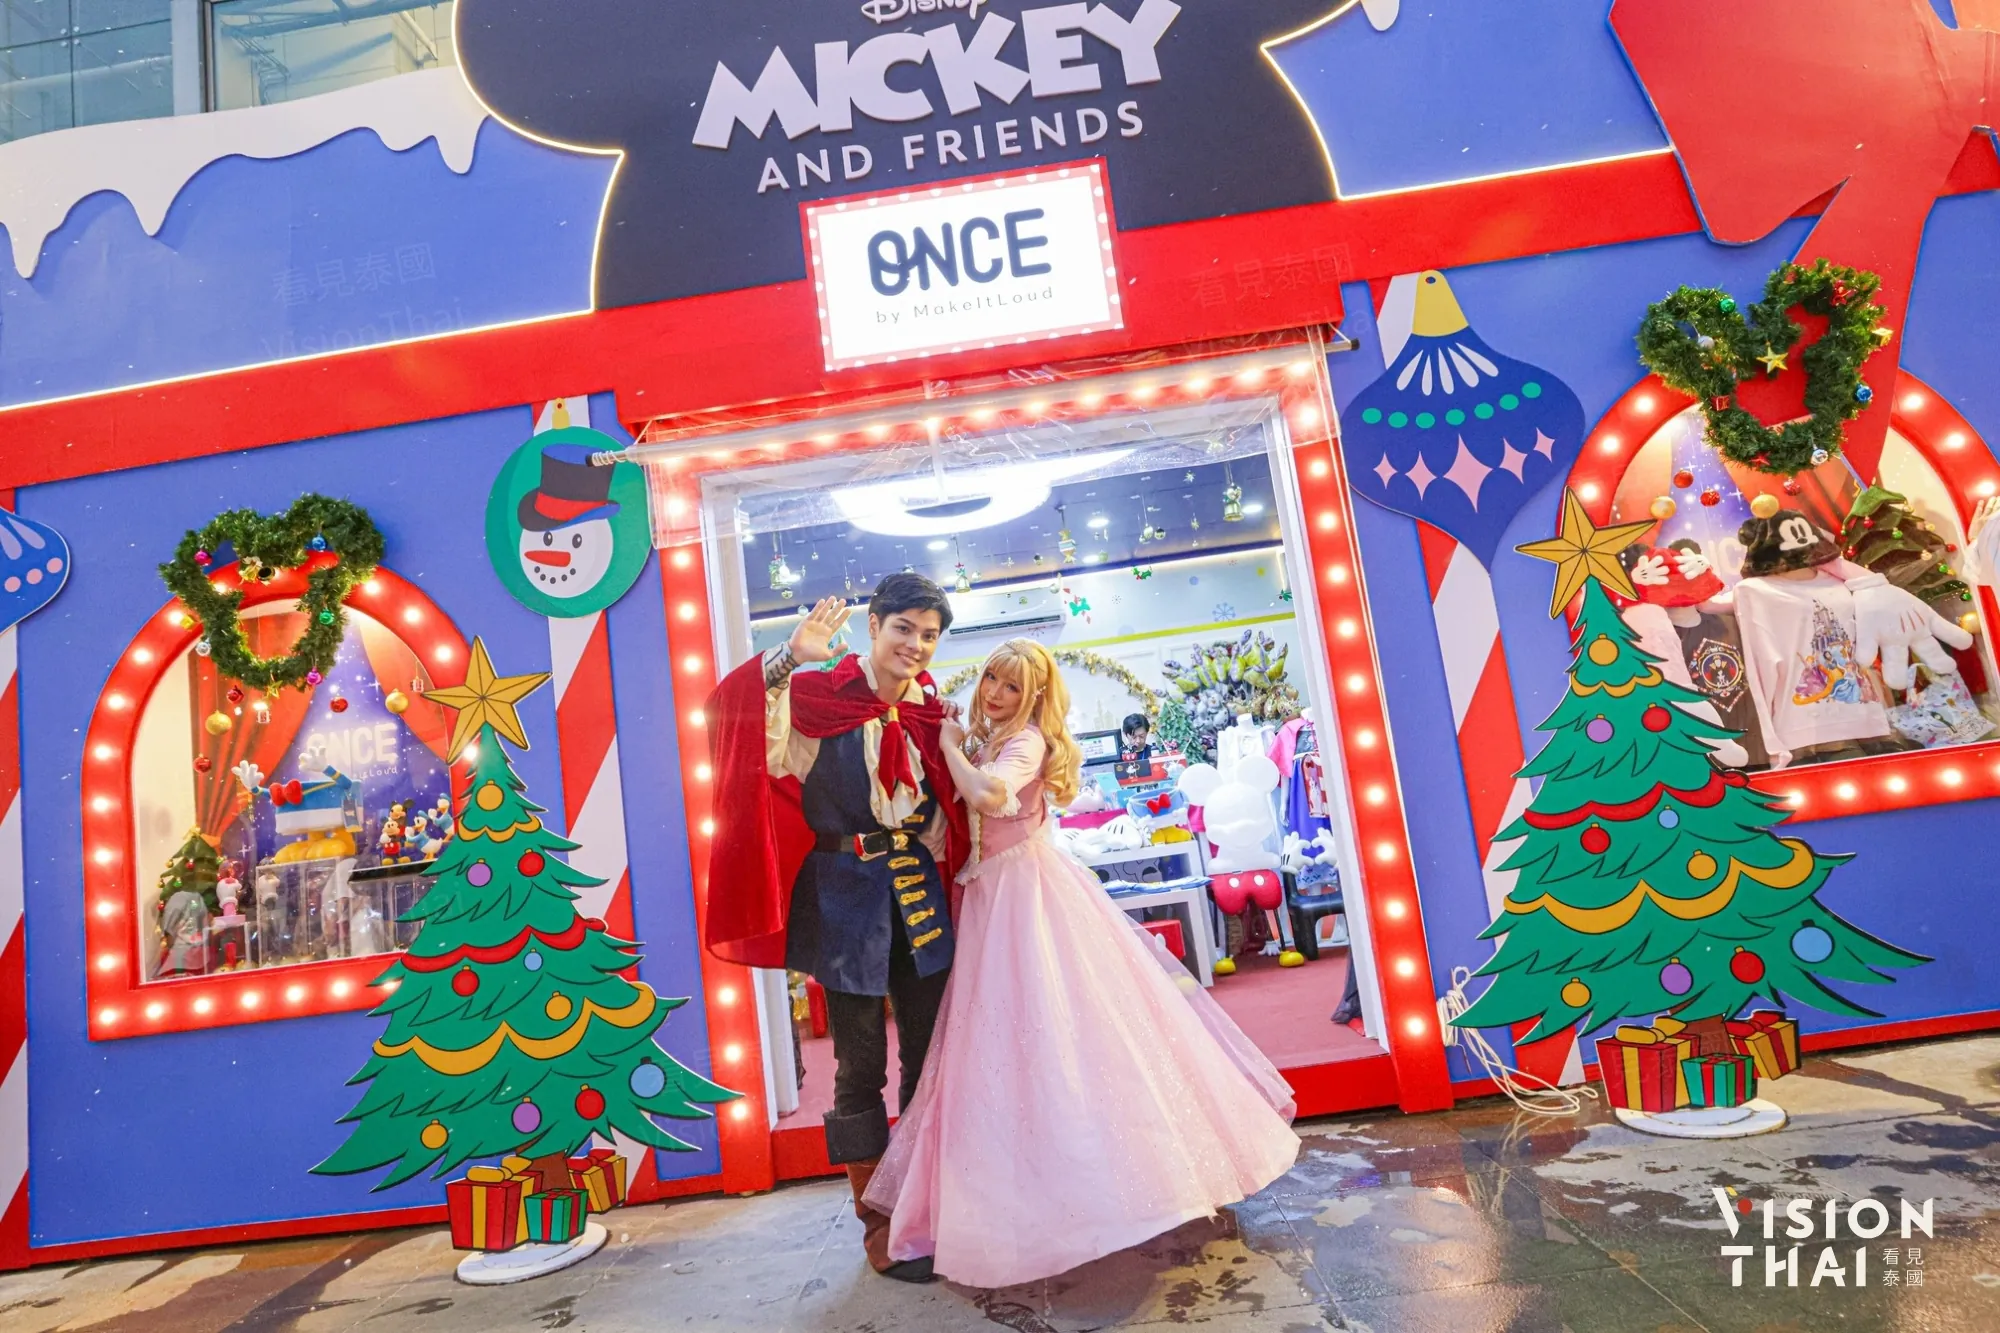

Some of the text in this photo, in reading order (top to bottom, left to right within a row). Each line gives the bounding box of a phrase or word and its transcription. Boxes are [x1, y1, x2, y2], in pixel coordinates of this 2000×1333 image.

[692, 0, 1182, 150] MICKEY
[757, 100, 1144, 193] AND FRIENDS
[867, 207, 1053, 297] ONCE
[875, 286, 1054, 325] by MakeItLoud
